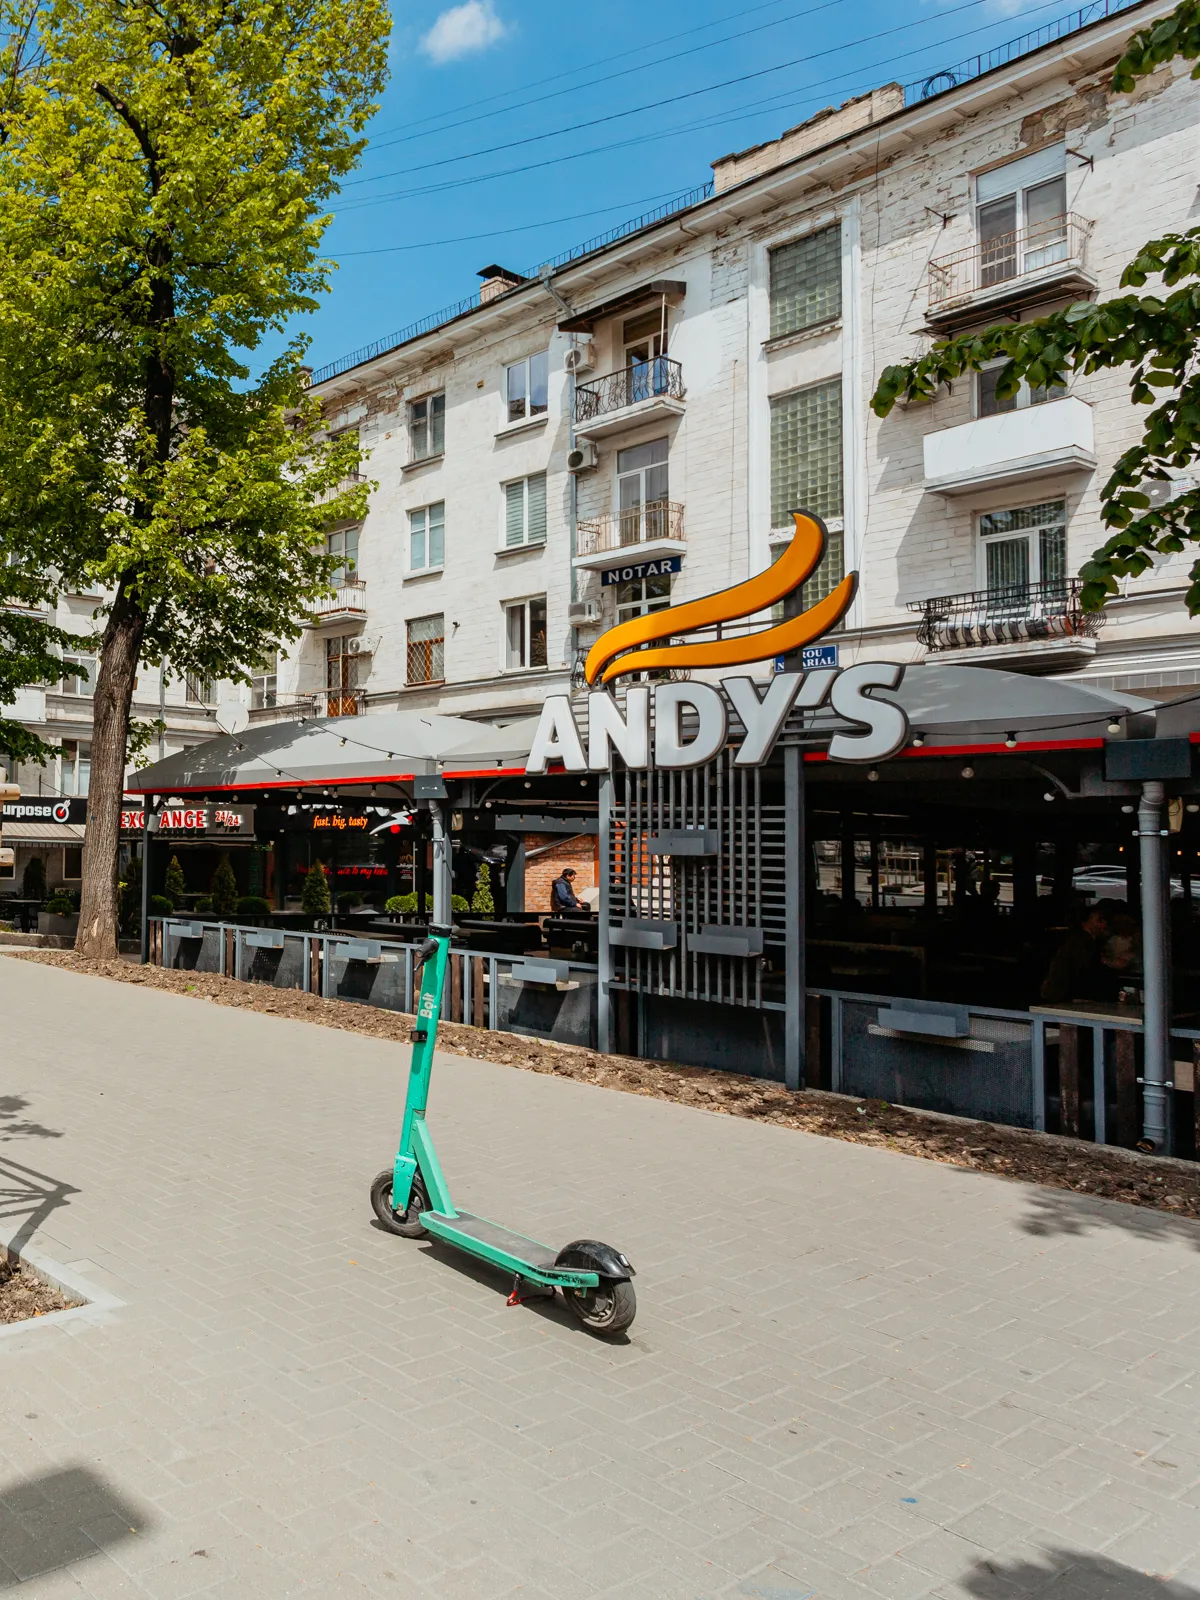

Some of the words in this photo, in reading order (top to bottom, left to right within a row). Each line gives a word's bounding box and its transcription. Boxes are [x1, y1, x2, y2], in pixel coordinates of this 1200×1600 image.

[608, 560, 673, 584] NOTAR
[778, 657, 834, 670] NRIAL
[524, 662, 910, 775] ANDY'S
[3, 805, 51, 817] urpose
[121, 810, 205, 828] EXCANGE
[215, 811, 241, 826] 24/24
[313, 815, 331, 829] fast.
[332, 815, 347, 830] big.
[349, 816, 369, 829] tasty
[420, 992, 435, 1019] Bolt
